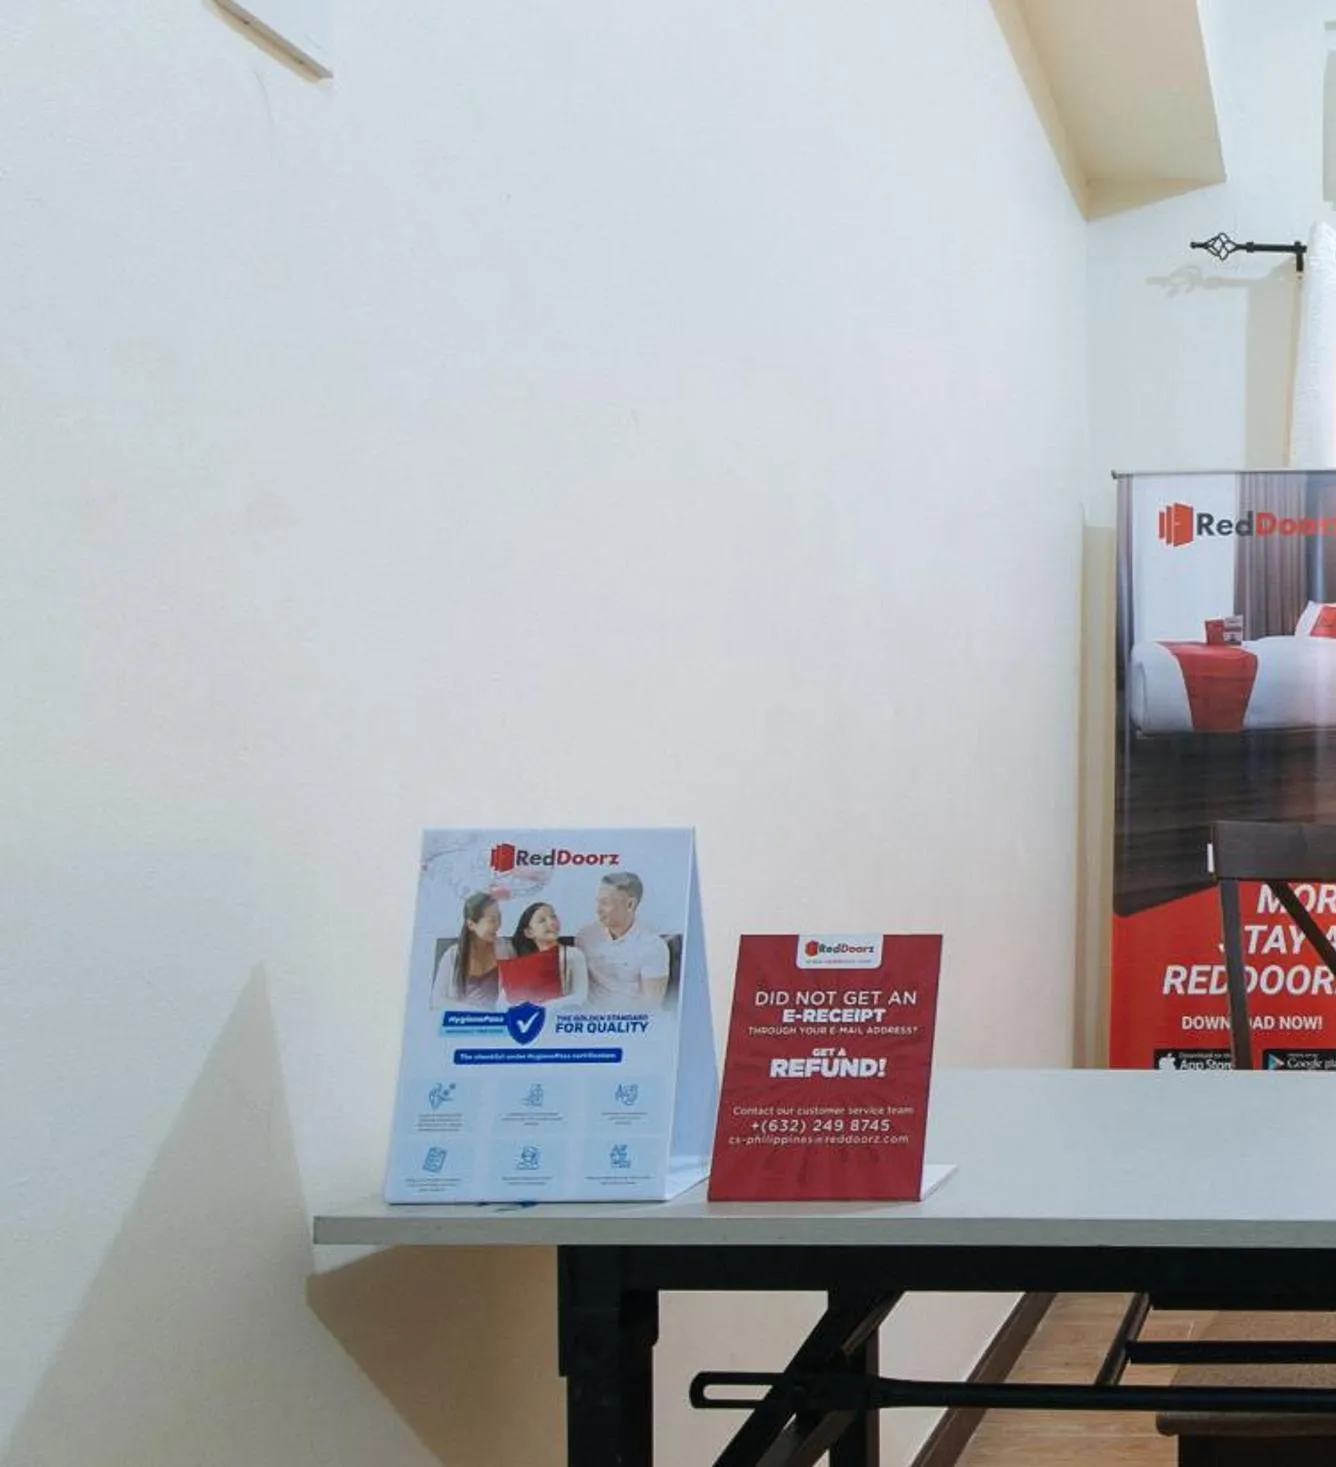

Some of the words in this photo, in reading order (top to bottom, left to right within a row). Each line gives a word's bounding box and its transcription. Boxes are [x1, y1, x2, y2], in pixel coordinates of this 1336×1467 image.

[516, 848, 620, 867] RedDoorz
[1218, 925, 1306, 955] TAY
[819, 943, 875, 954] RedDoorz
[755, 991, 789, 1006] DID
[795, 991, 837, 1006] NOT
[843, 991, 883, 1006] GET
[887, 991, 917, 1006] AN
[782, 1008, 886, 1023] E-RECEIPT
[555, 1021, 584, 1034] FOR
[587, 1021, 649, 1034] QUALITY
[1181, 1015, 1275, 1031] DOWNAD
[1279, 1015, 1324, 1031] NOW!
[748, 1026, 797, 1035] THROUGH
[800, 1026, 827, 1035] YOUR
[812, 1048, 835, 1057] GET
[837, 1048, 847, 1057] A
[769, 1058, 887, 1078] REFUND!
[1180, 1059, 1205, 1070] App
[1287, 1056, 1322, 1070] Google
[732, 1106, 773, 1116] Contact
[775, 1107, 794, 1116] our
[796, 1106, 845, 1116] customer
[848, 1106, 885, 1116] service
[887, 1106, 914, 1116] team
[751, 1119, 806, 1134] +(632)
[812, 1119, 844, 1132] 249
[850, 1119, 891, 1132] 8745
